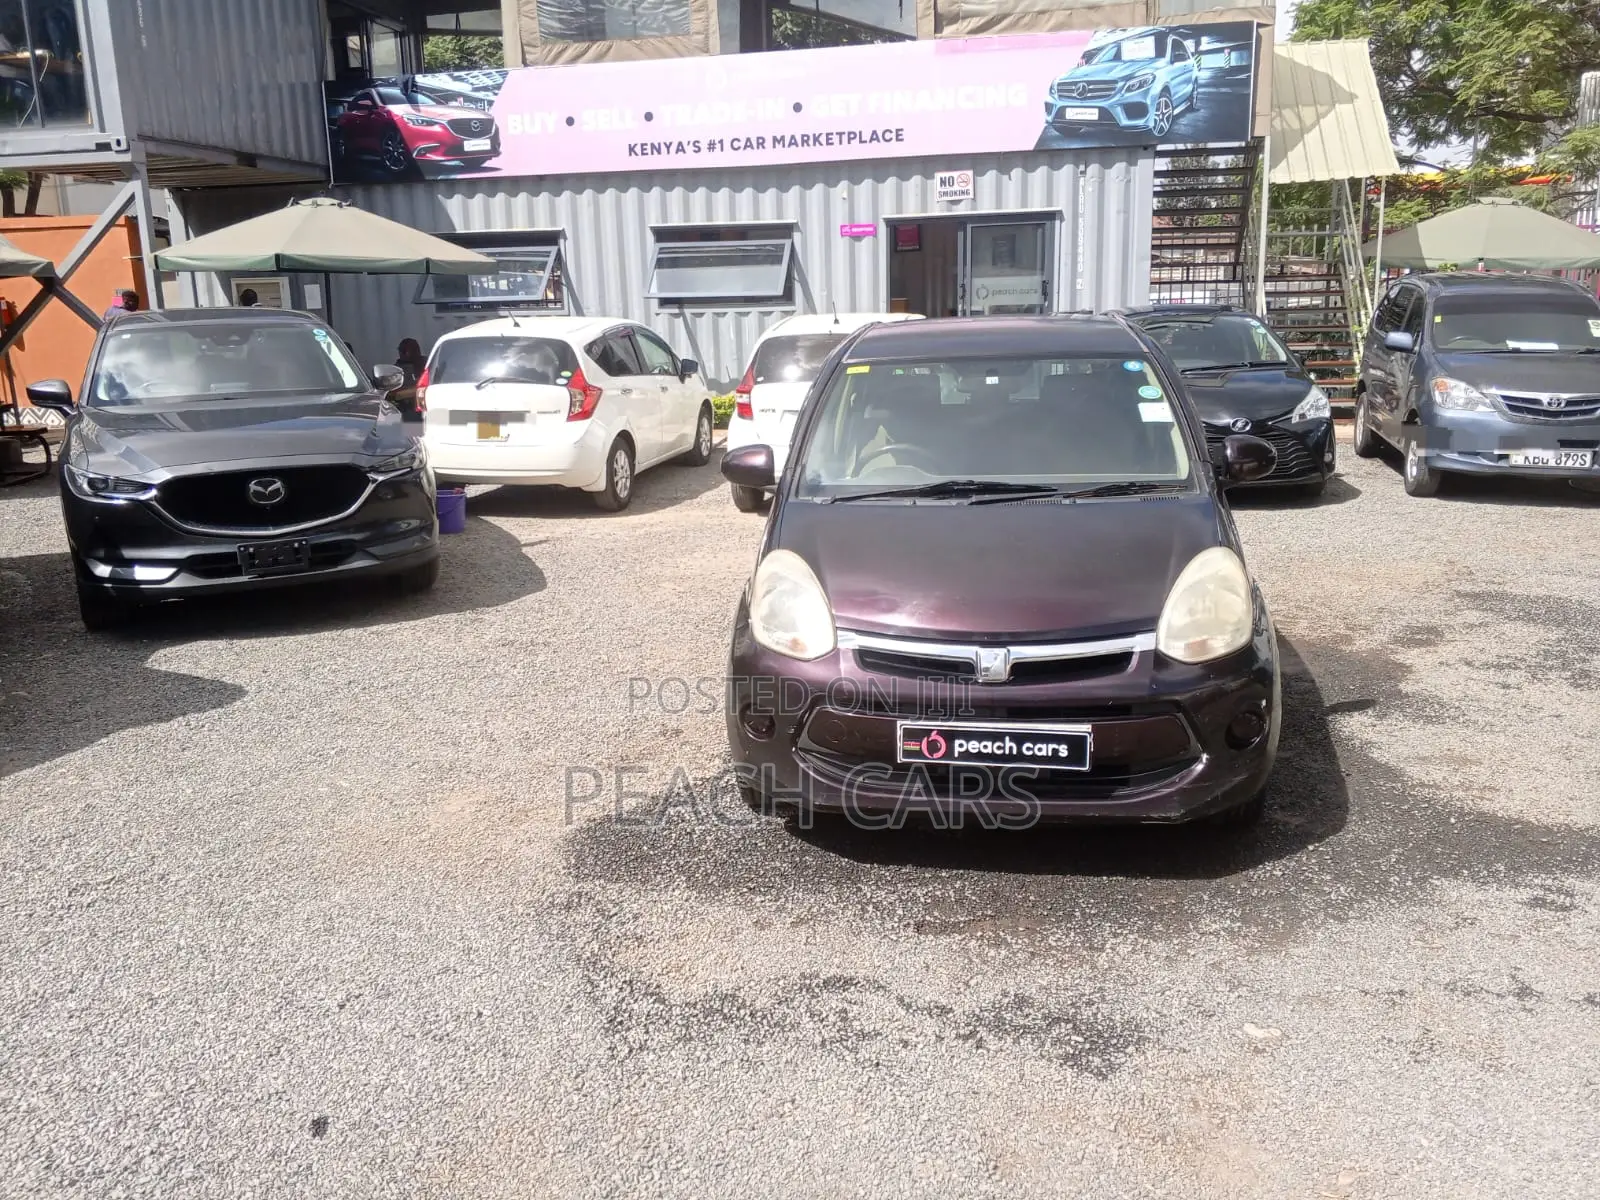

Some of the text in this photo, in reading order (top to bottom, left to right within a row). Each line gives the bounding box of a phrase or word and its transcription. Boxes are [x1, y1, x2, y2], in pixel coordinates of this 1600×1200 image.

[507, 82, 1028, 135] BUY SELL TRADE-IN GET FINANCING
[628, 128, 905, 157] KENYA'S #1 CAR MARKETPLACE
[939, 175, 955, 188] NO
[938, 188, 971, 199] SMOKING
[954, 735, 1069, 758] peach cars
